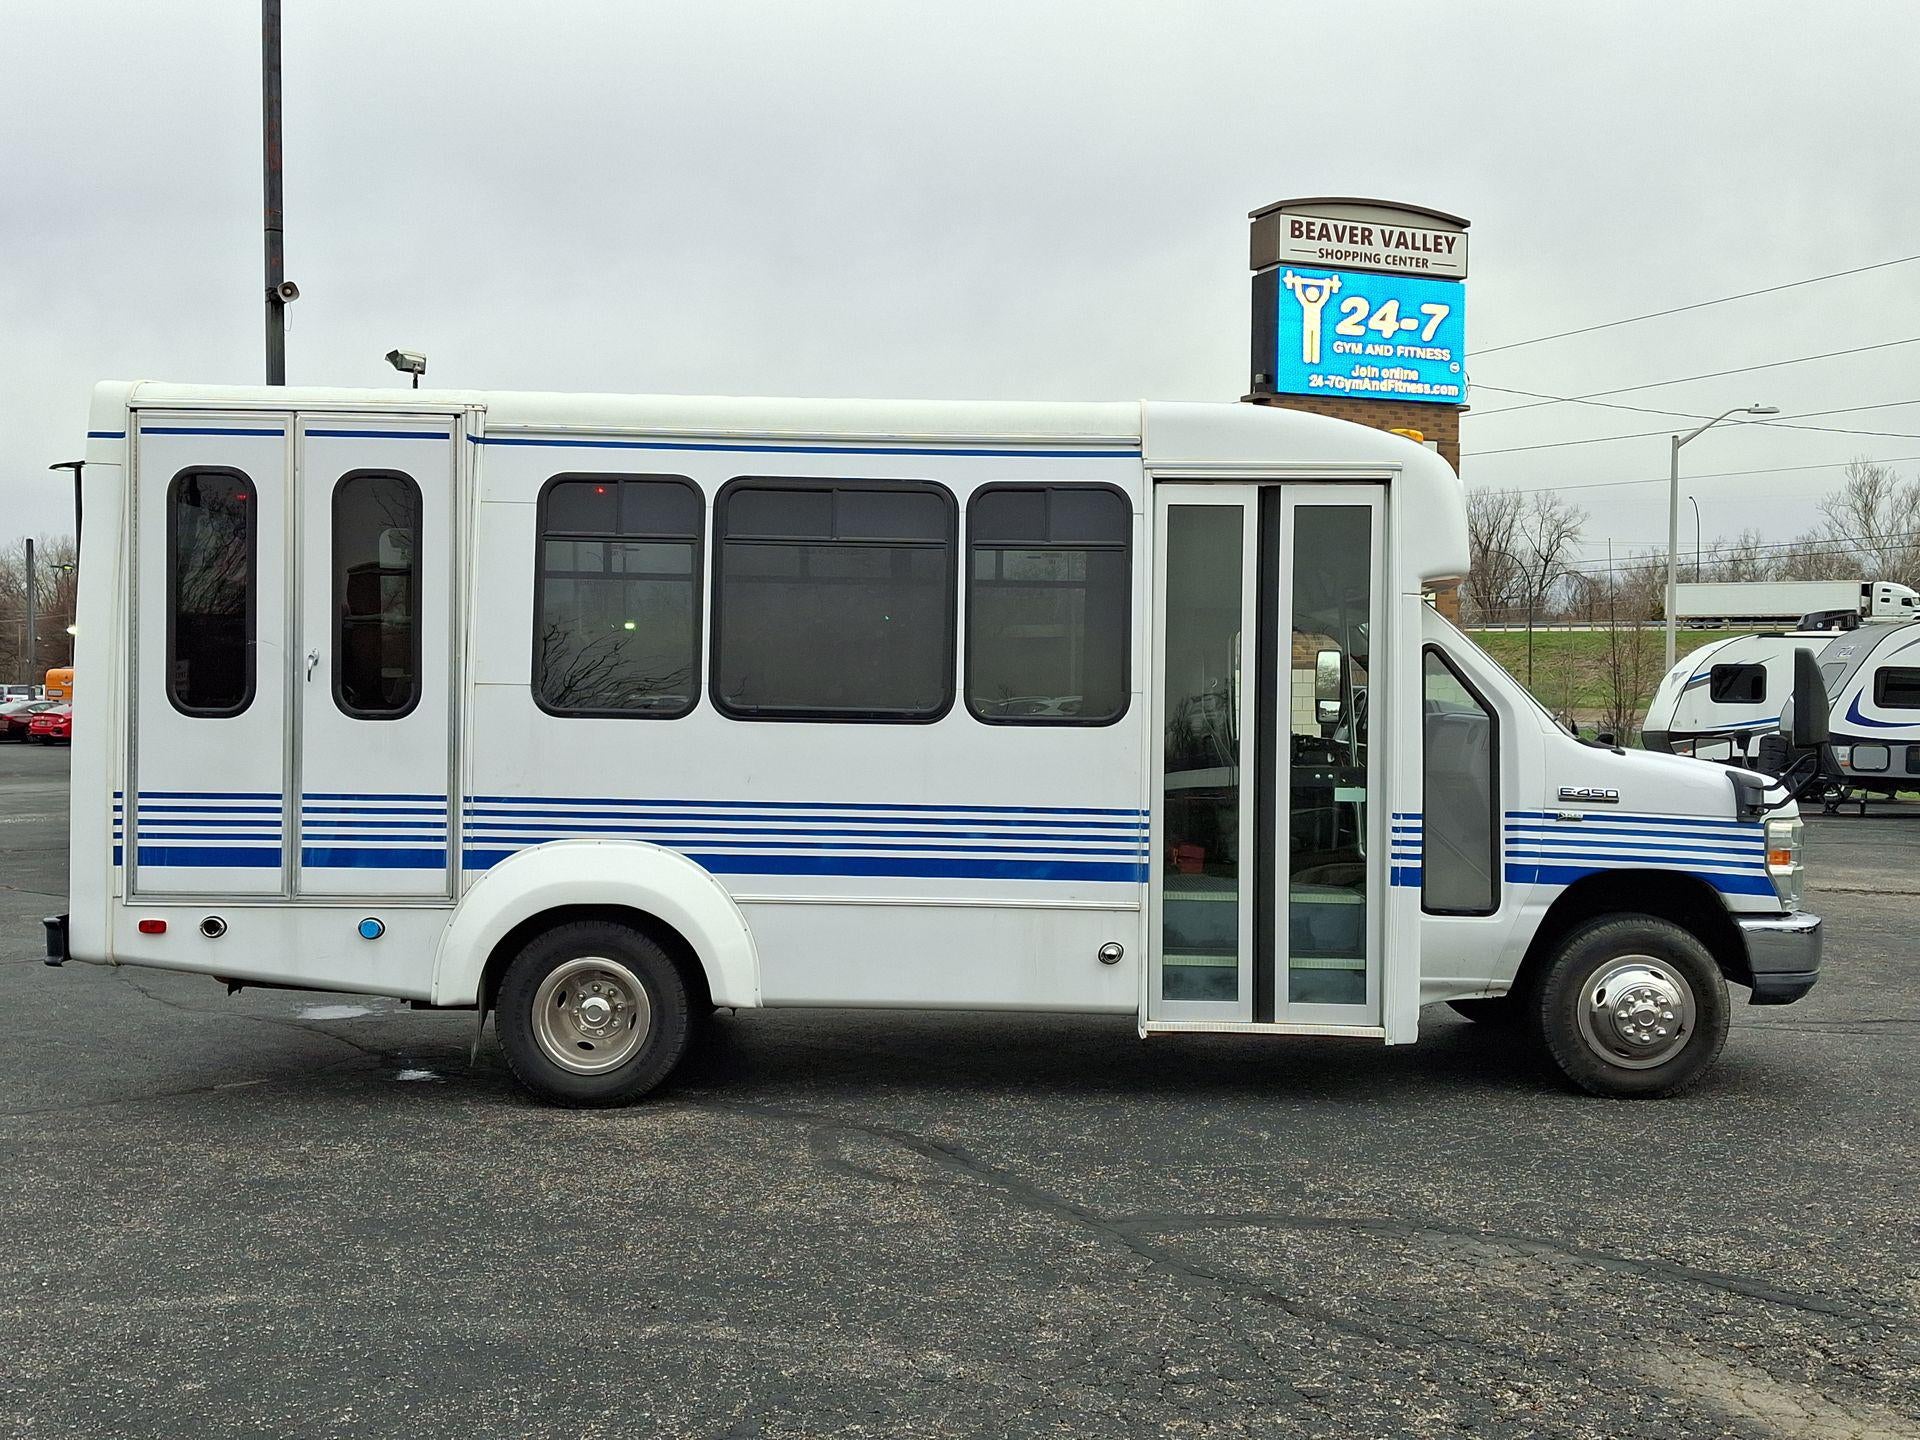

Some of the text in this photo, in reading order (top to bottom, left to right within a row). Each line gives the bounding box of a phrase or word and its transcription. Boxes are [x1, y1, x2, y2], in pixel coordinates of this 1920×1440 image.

[1290, 219, 1457, 254] BEAVER VALLEY
[1318, 248, 1429, 269] SHOPPING CENTER
[1335, 297, 1450, 342] 24-7
[1333, 341, 1451, 361] GYM AND FITNESS
[1351, 364, 1419, 380] Join online
[1308, 374, 1459, 397] 24-7GymAndFitness.com
